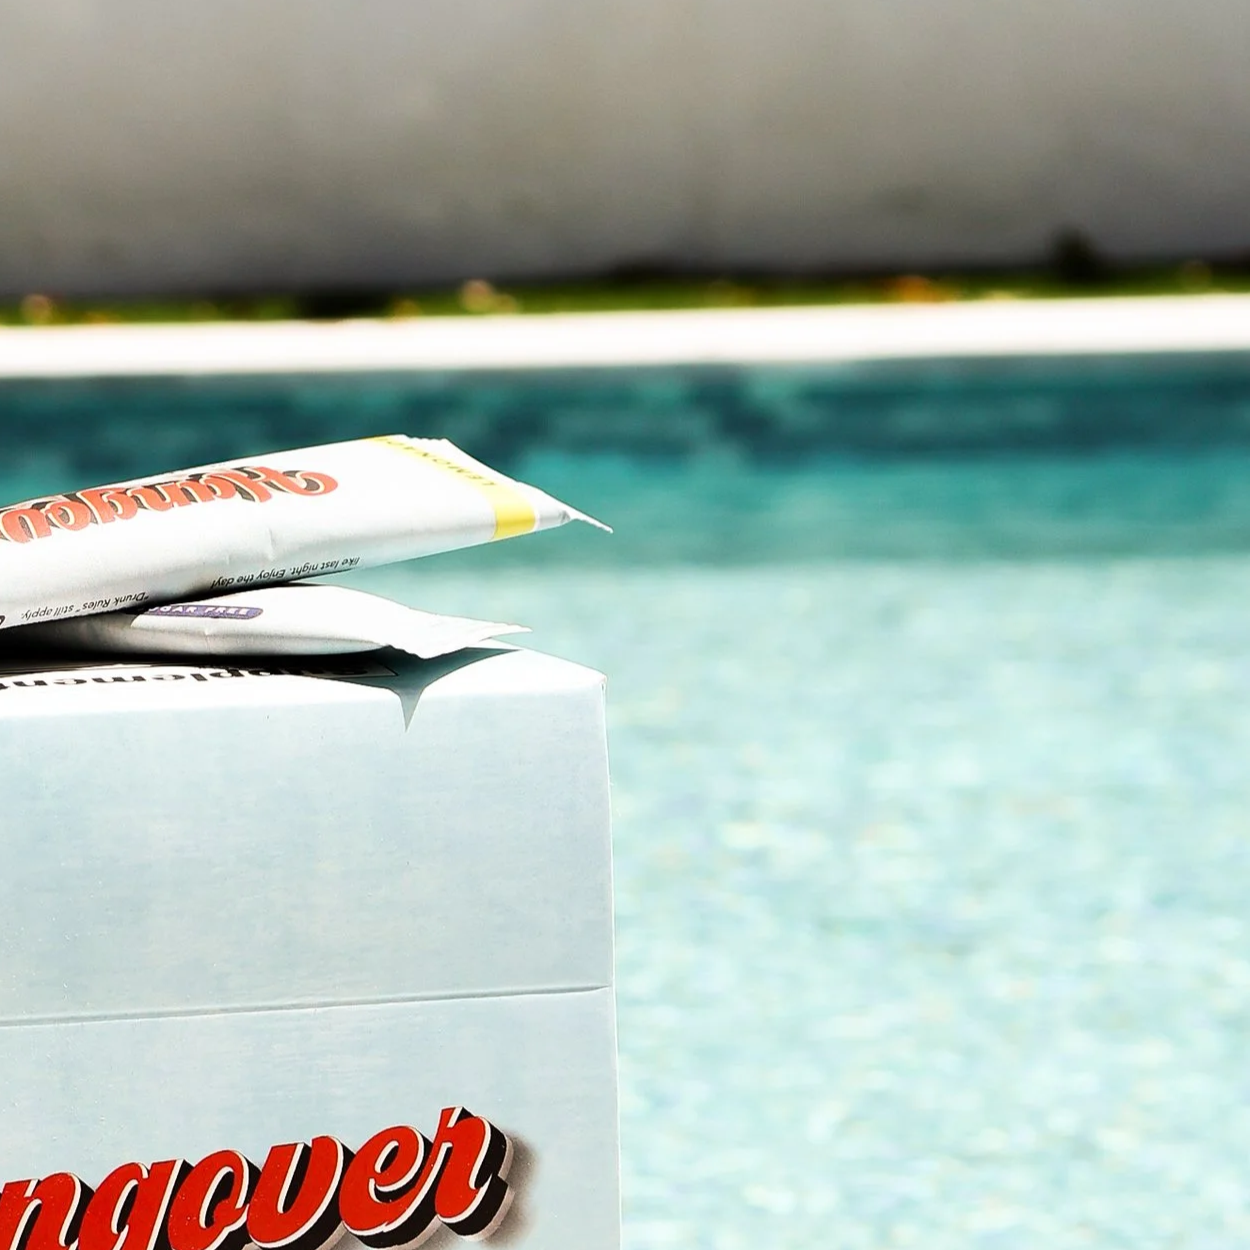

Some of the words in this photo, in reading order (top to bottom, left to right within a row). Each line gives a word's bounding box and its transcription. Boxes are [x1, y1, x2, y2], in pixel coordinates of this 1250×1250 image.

[320, 560, 339, 571] last
[341, 556, 360, 567] like
[256, 569, 285, 583] Enjoy
[289, 563, 319, 577] night.
[211, 577, 235, 589] day!
[237, 574, 253, 584] the
[21, 607, 53, 621] apply.
[54, 605, 74, 617] still
[204, 607, 249, 615] FREE
